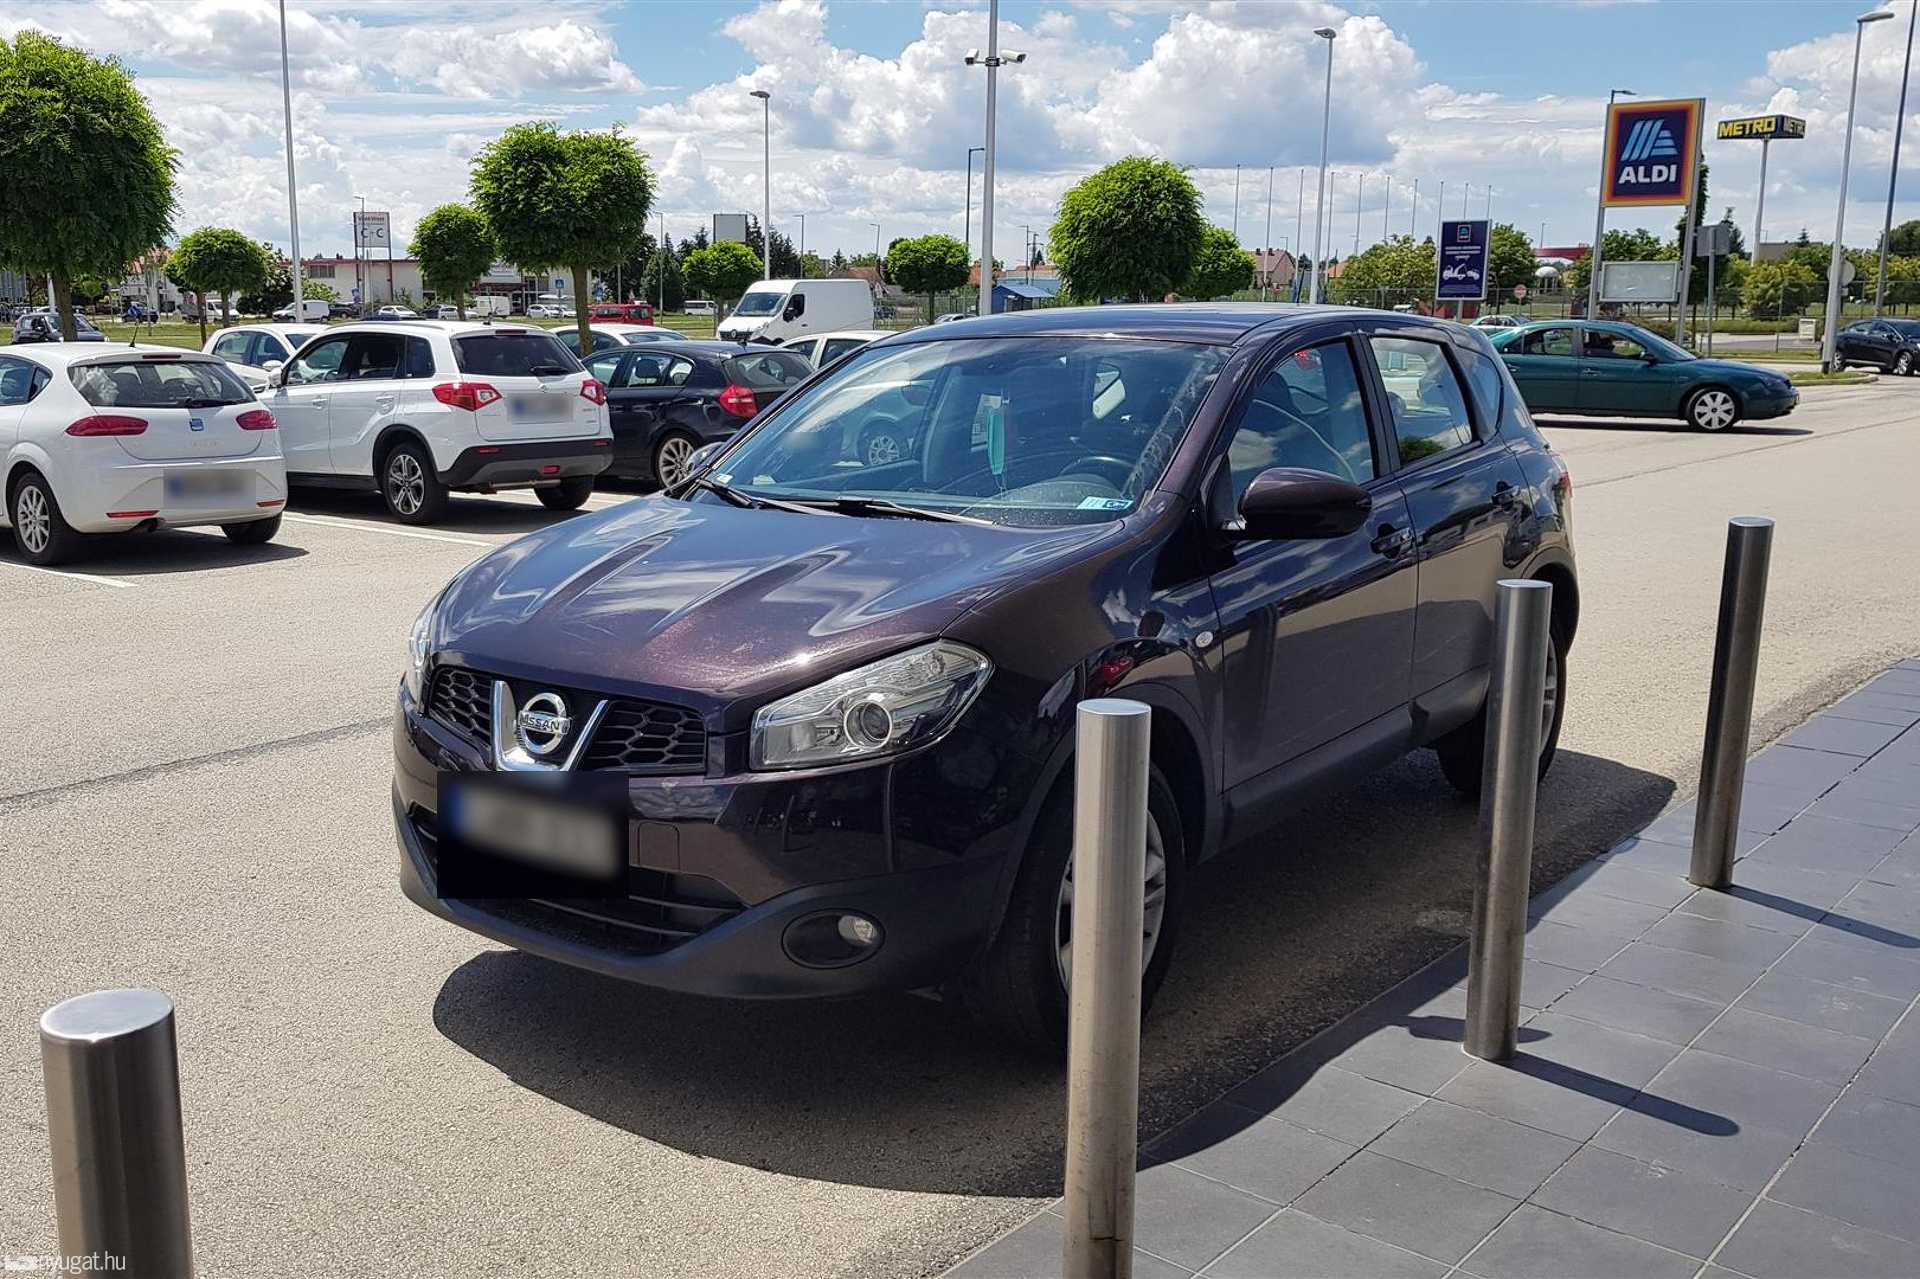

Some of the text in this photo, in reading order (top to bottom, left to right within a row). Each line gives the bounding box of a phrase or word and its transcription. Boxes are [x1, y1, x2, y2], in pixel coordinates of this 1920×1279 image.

[1719, 116, 1777, 137] METRO
[1618, 165, 1677, 184] ALDI
[520, 713, 560, 733] NISSAN
